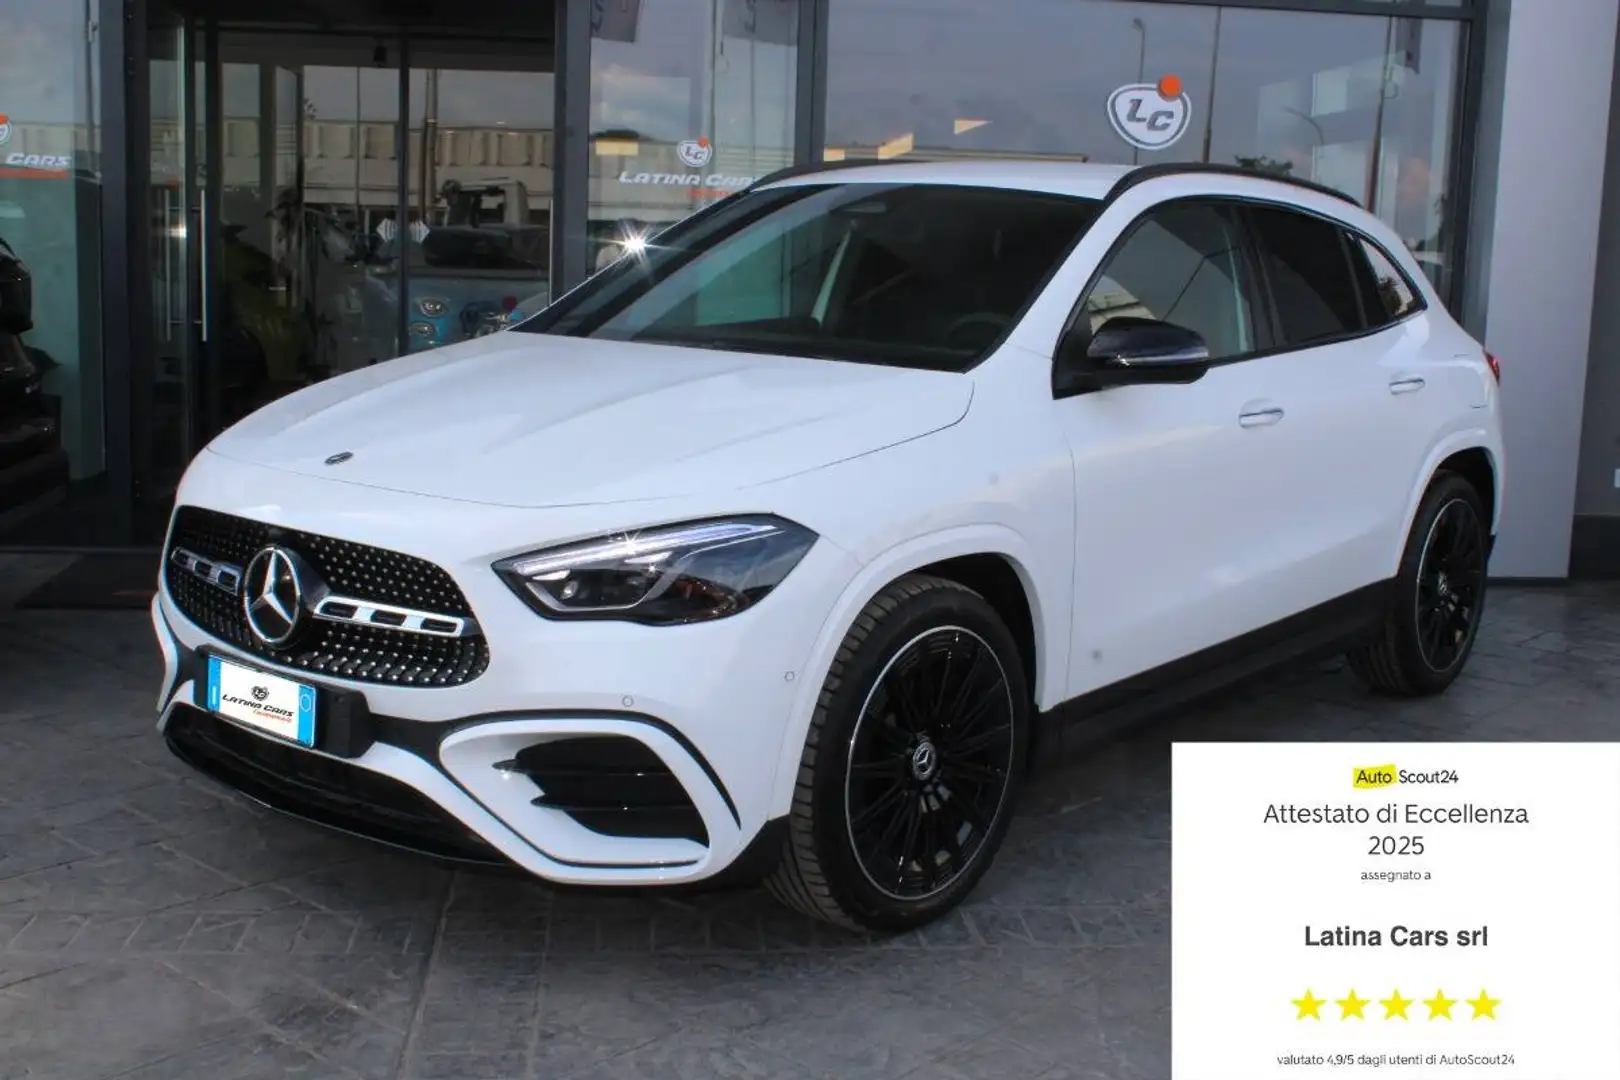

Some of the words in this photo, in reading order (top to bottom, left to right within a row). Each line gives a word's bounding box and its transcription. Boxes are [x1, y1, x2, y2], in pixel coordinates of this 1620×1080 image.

[1126, 98, 1175, 132] LC
[619, 171, 700, 185] LATINA
[222, 694, 262, 708] LATINA
[263, 704, 294, 717] CARS
